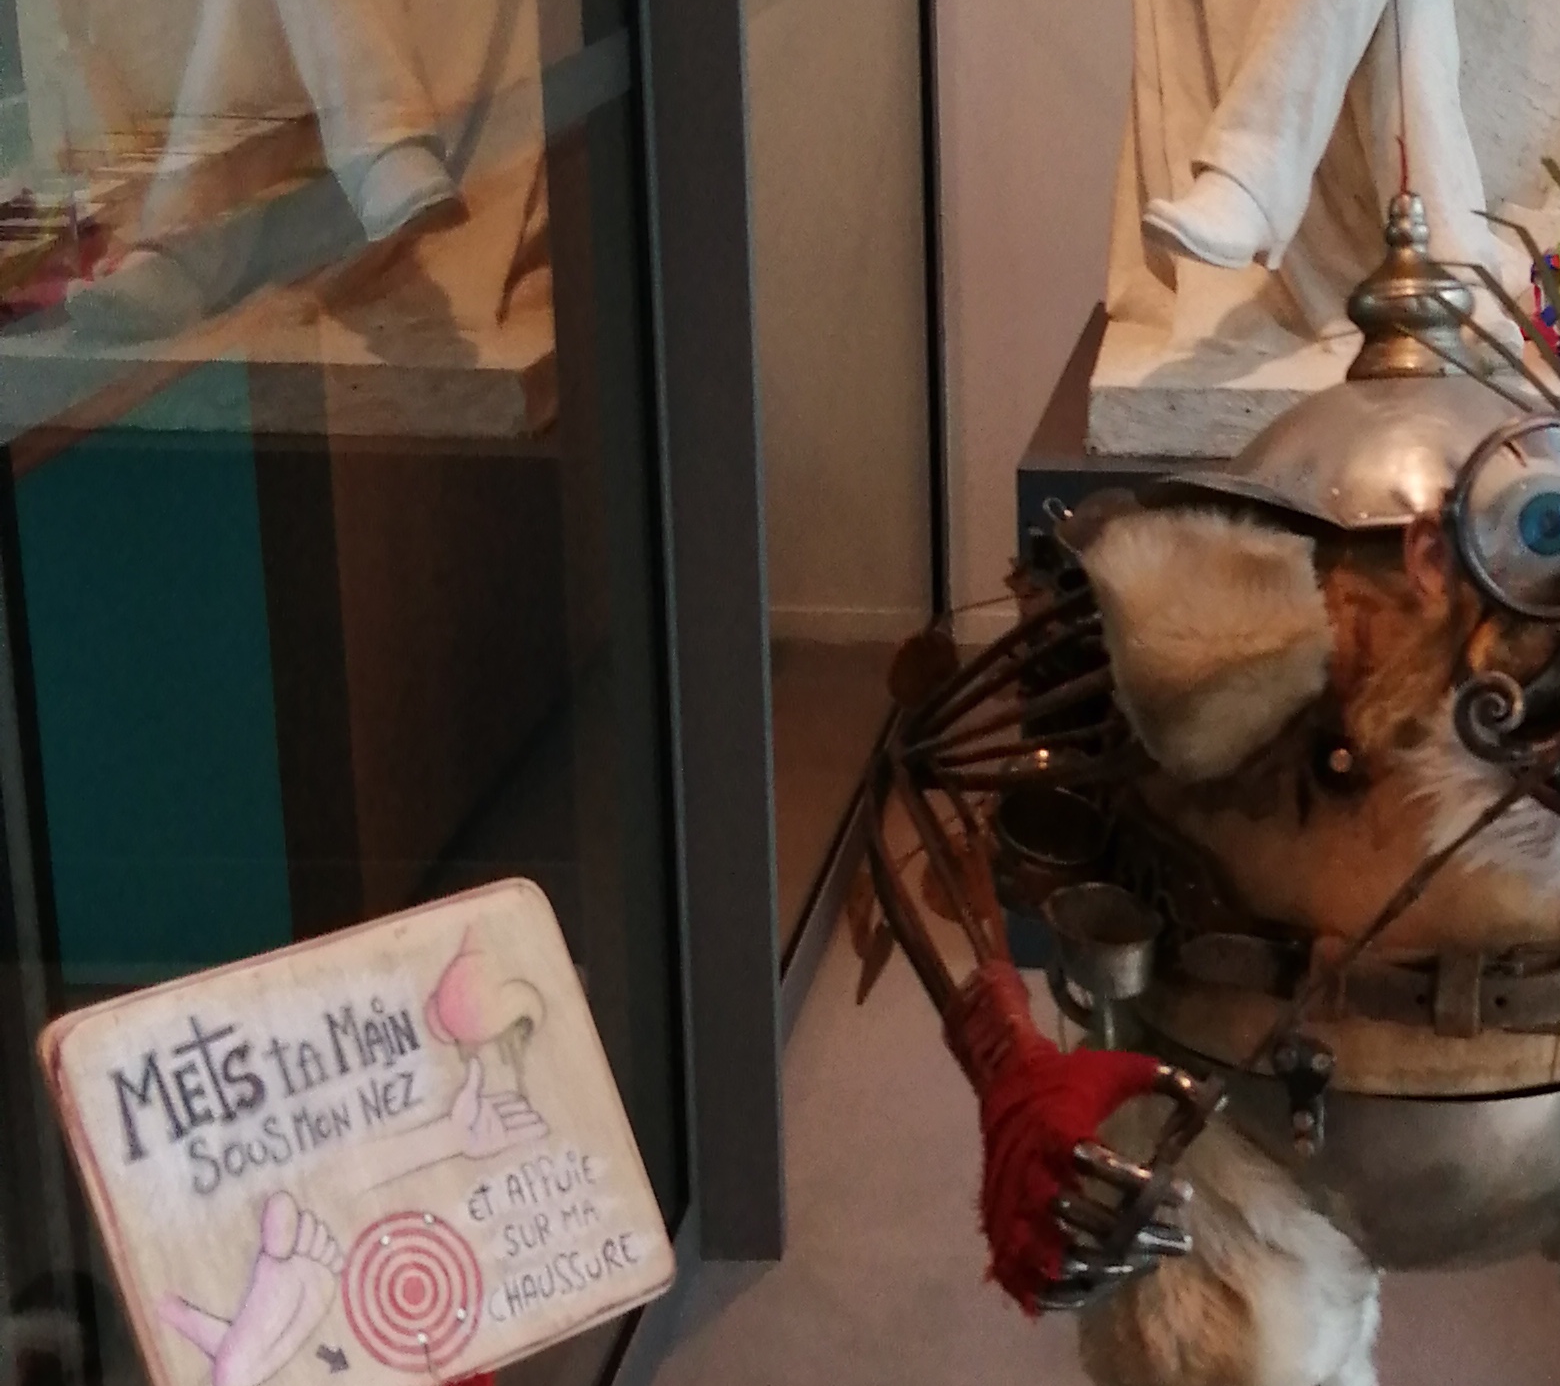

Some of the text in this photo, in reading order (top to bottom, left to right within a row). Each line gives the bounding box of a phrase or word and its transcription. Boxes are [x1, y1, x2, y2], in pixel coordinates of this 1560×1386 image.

[110, 1015, 266, 1163] METS
[189, 1072, 424, 1196] SOUS MON NEZ
[467, 1184, 494, 1222] ET
[503, 1199, 601, 1257] SUR MA
[488, 1231, 641, 1323] CHAUSSURE
